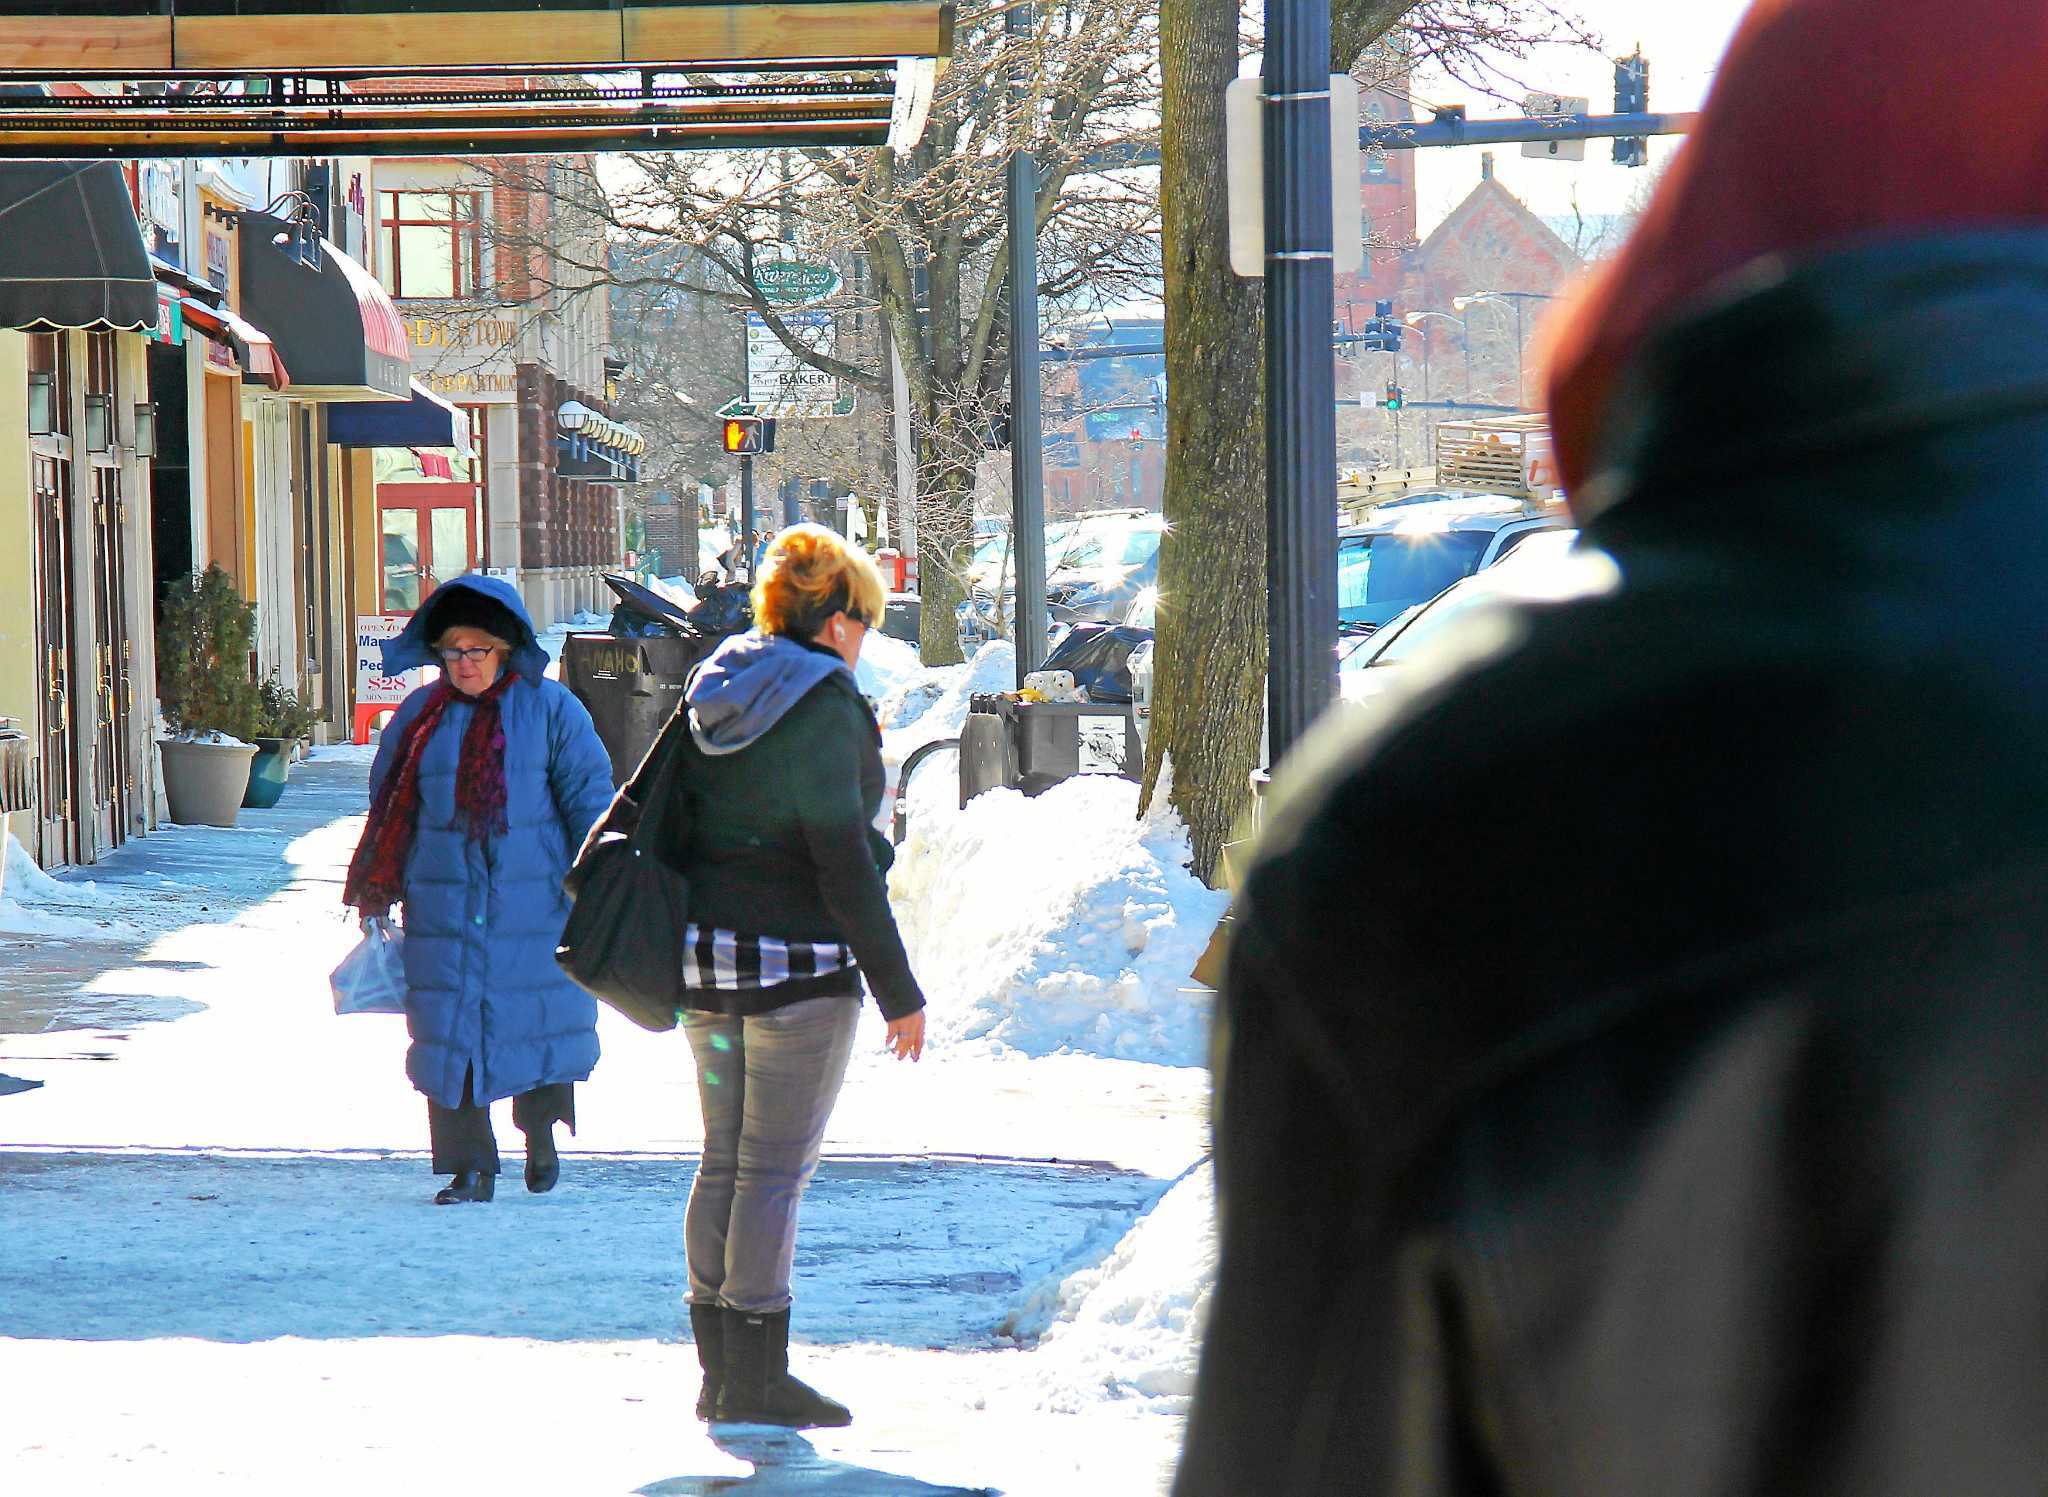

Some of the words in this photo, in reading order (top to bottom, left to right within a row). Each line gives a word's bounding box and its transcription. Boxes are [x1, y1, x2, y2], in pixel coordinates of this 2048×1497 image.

[780, 373, 832, 385] BAKERY
[360, 624, 385, 632] OPEN
[368, 676, 406, 691] $28
